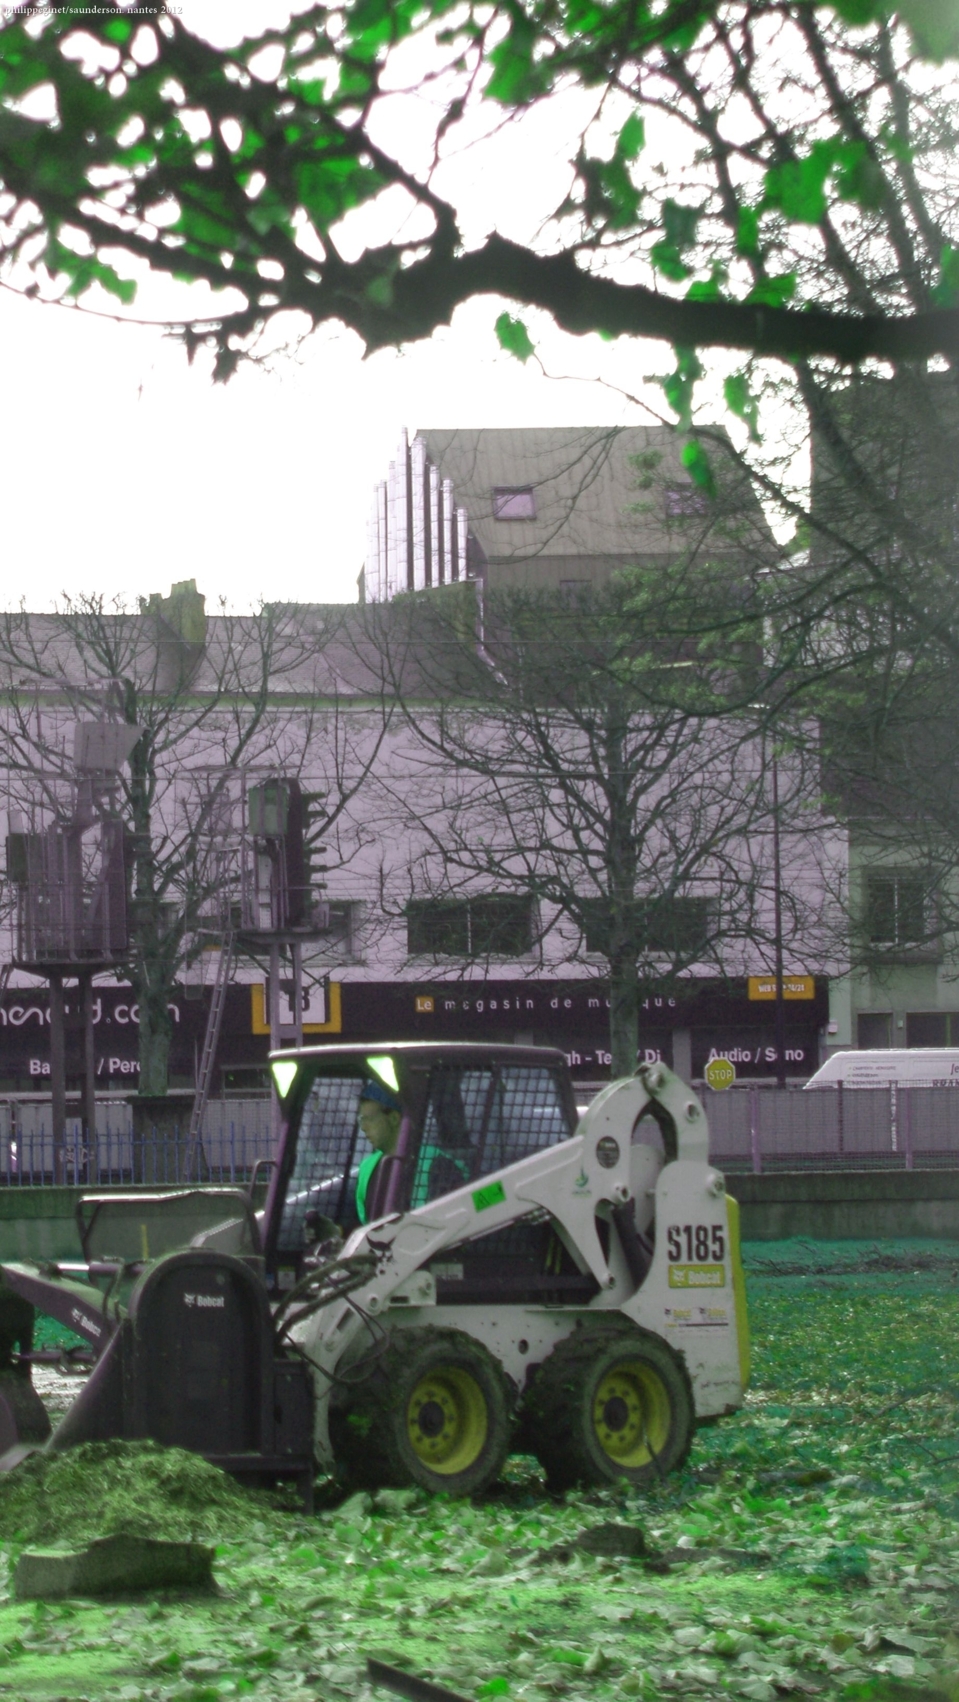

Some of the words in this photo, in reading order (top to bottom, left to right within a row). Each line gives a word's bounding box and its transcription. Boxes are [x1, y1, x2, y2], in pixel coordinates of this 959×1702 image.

[416, 999, 432, 1010] Le
[550, 997, 572, 1009] de
[708, 1047, 751, 1062] Audio
[765, 1047, 804, 1062] Sno
[709, 1069, 732, 1080] STOP
[667, 1224, 725, 1262] S185
[197, 1296, 225, 1307] Bobcat
